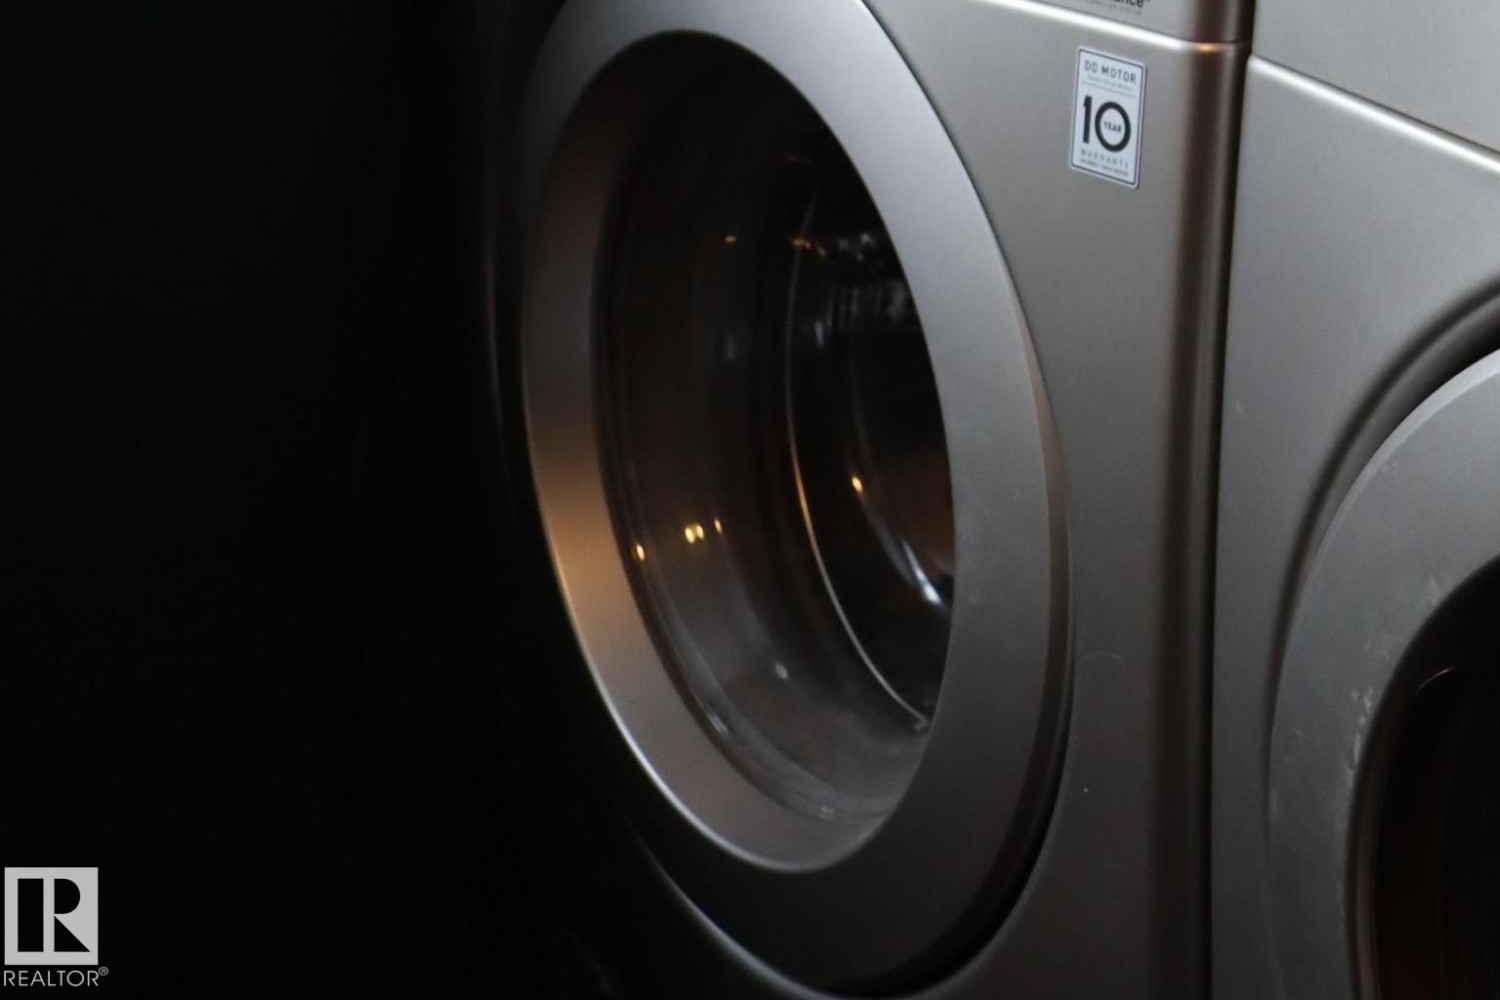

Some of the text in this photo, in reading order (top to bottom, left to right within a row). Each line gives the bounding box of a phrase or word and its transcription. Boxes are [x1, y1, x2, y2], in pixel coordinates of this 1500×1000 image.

[1084, 60, 1099, 73] DD
[1101, 64, 1138, 85] MOTOR
[1082, 95, 1131, 152] 10
[1103, 121, 1122, 133] YEAR
